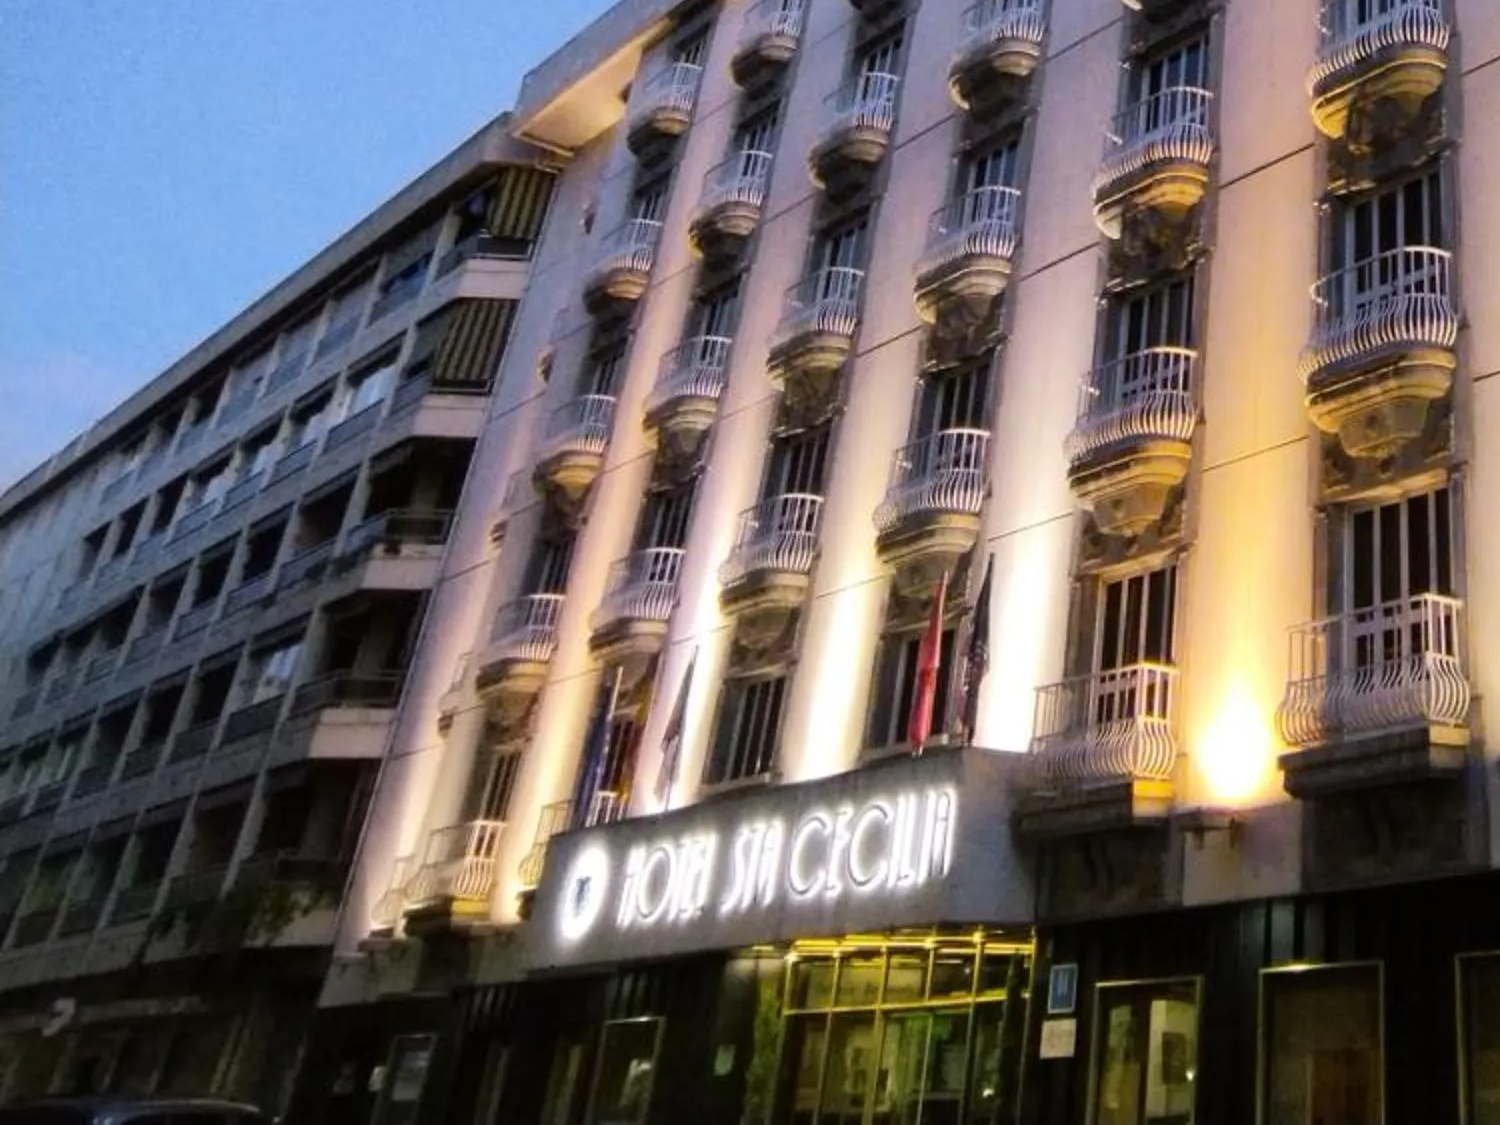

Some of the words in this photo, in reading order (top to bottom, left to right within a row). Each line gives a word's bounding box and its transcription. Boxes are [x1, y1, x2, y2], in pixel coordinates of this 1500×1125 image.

[616, 835, 717, 925] HOTEL
[722, 819, 784, 913] STA
[789, 787, 956, 898] CECILIA
